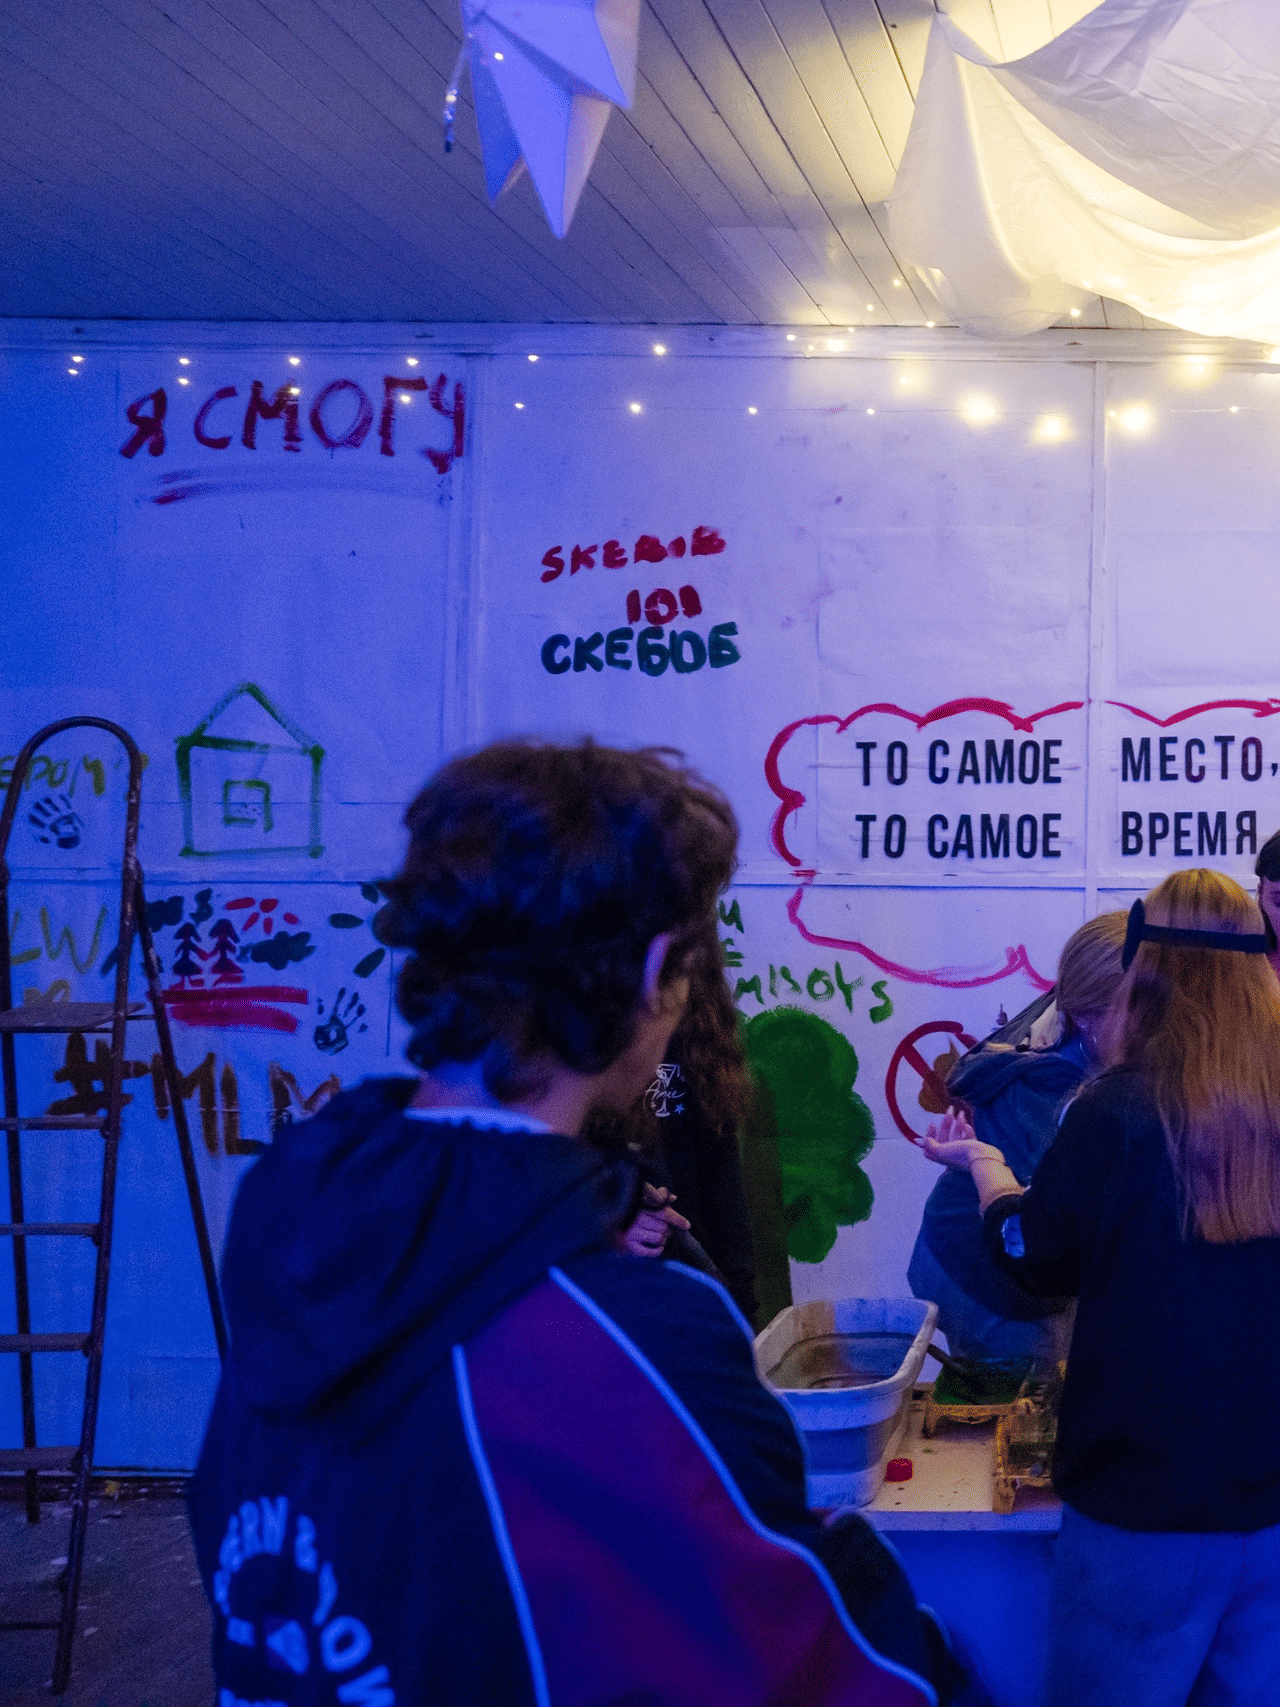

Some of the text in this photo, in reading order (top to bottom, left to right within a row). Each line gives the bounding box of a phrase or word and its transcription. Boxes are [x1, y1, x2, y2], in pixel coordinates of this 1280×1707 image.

[119, 373, 467, 475] Я СМОГУ
[626, 585, 702, 626] 101
[540, 621, 741, 677] СКЕБОБ
[856, 735, 1279, 786] ТО САМОЕ МЕСТО,
[856, 810, 1258, 858] ТО САМОЕ ВРЕМЯ
